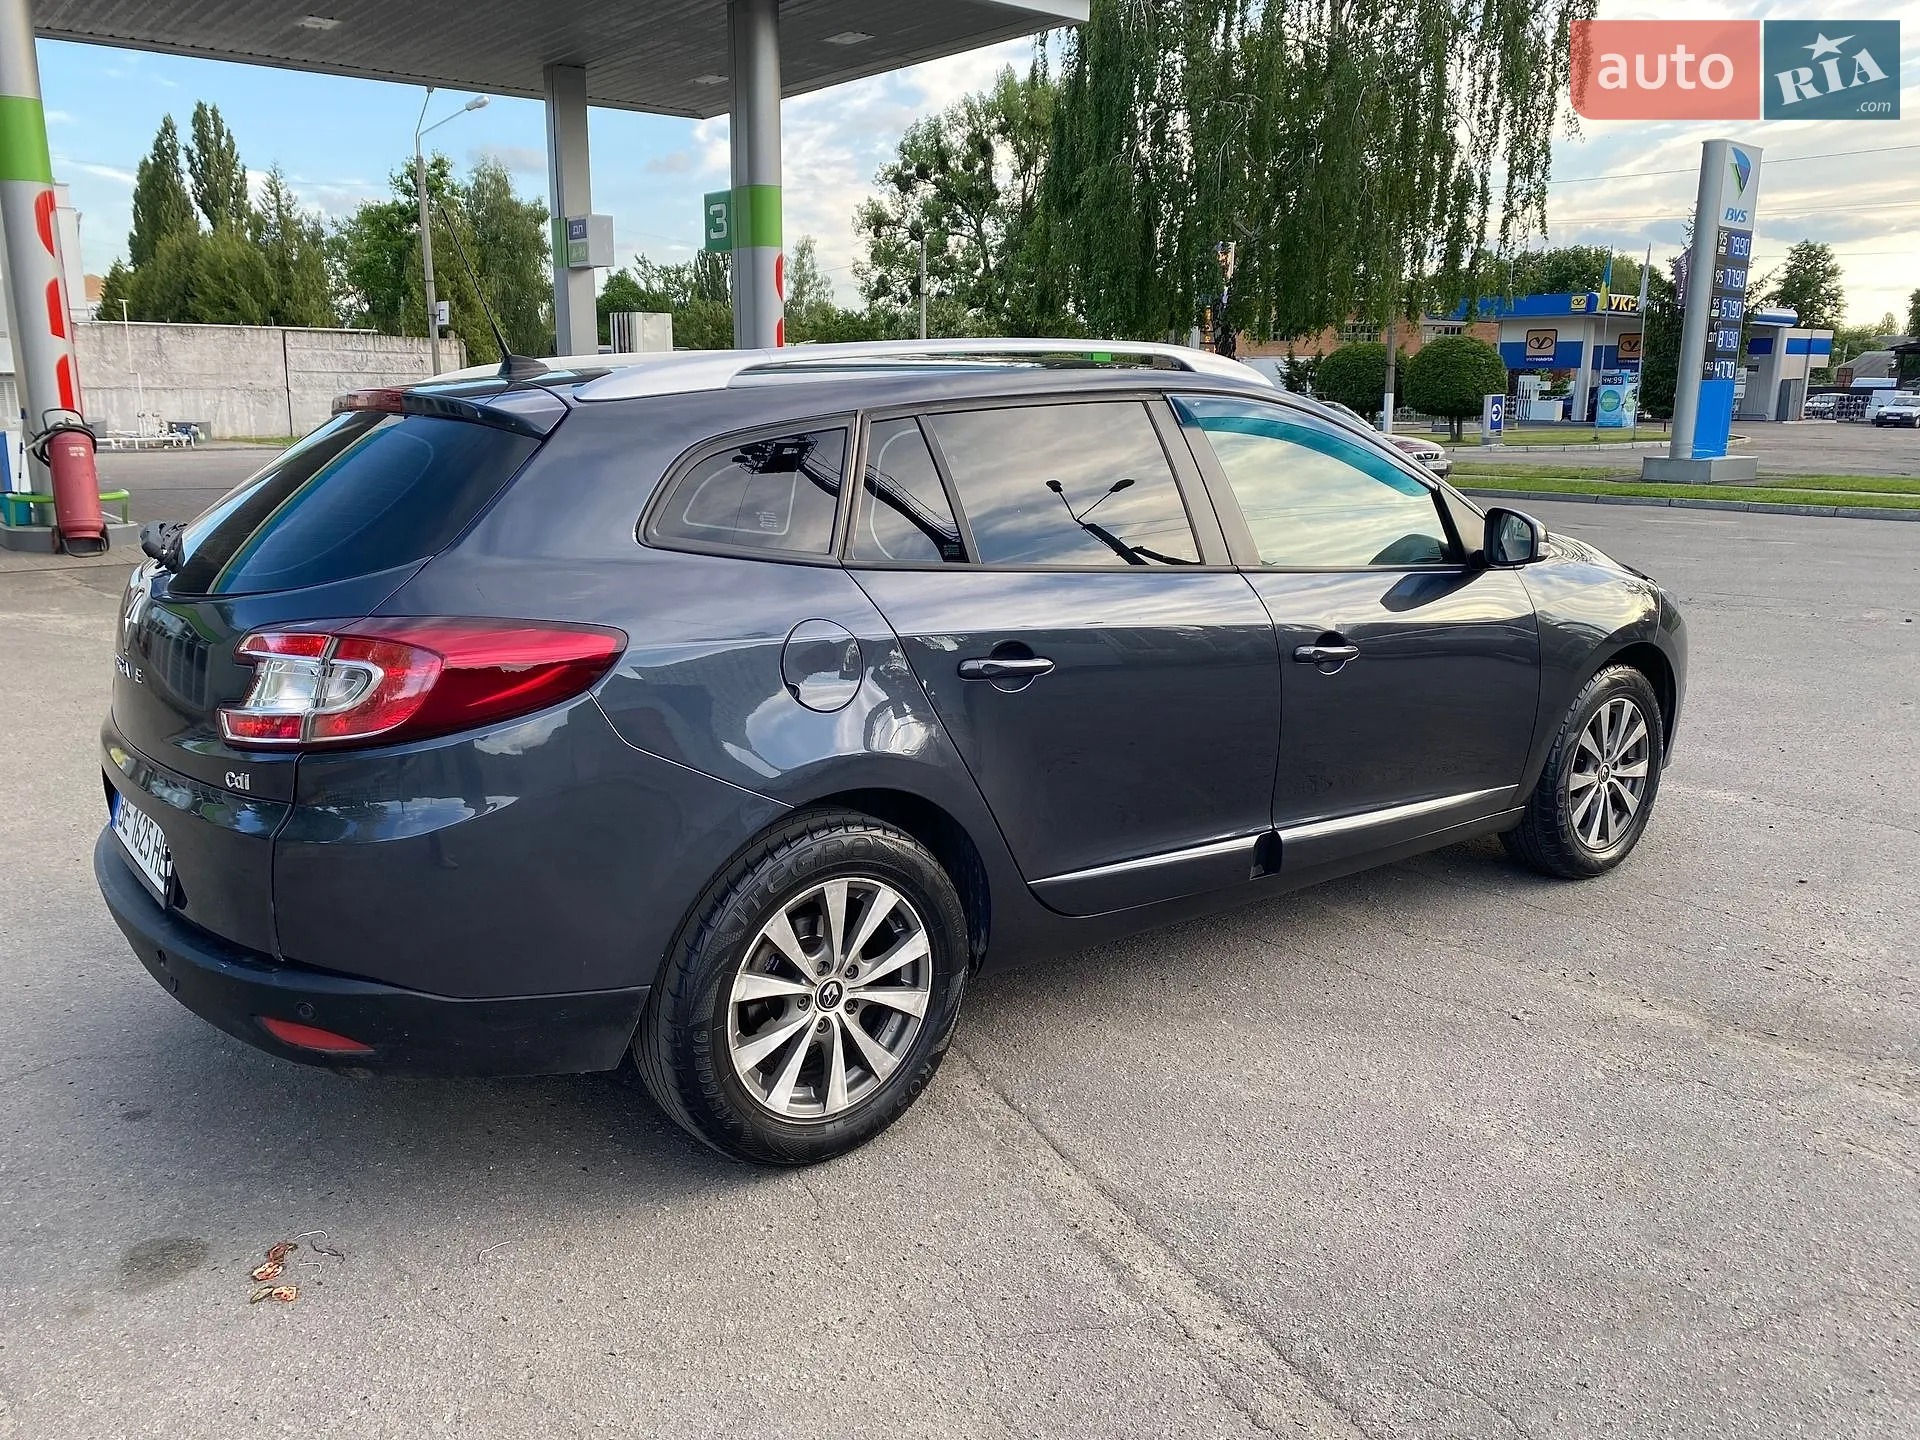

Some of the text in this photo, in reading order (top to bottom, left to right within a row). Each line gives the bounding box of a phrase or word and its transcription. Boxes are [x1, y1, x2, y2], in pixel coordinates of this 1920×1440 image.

[709, 203, 727, 239] 3
[1725, 207, 1748, 223] BVS
[1719, 232, 1728, 246] 95
[1715, 269, 1724, 284] 95
[1611, 296, 1639, 311] УКР
[131, 810, 154, 861] 1625
